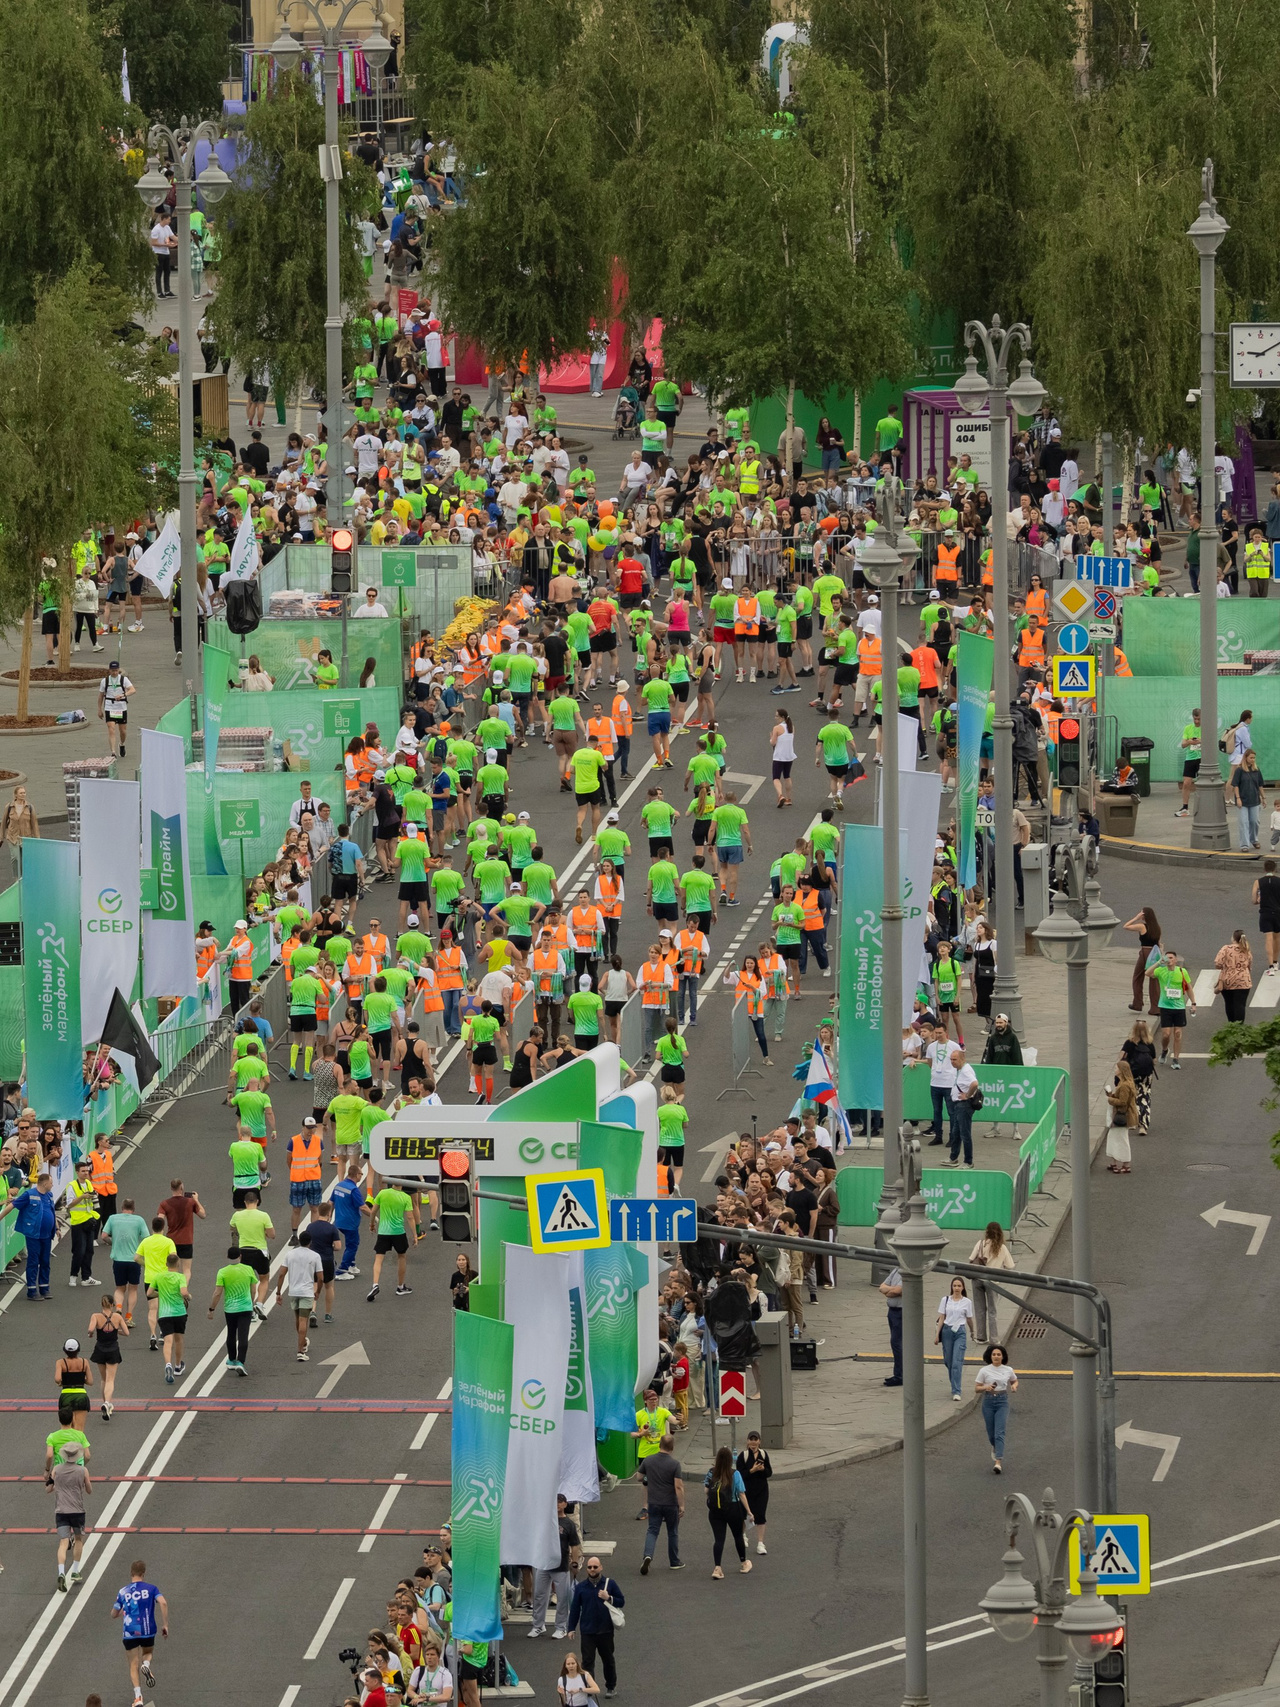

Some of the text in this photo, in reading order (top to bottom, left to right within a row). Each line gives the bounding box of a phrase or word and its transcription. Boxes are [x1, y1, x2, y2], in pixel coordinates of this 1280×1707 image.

[955, 424, 991, 432] ОШИБ
[955, 434, 976, 443] 404
[160, 827, 175, 887] Прайм
[87, 919, 133, 934] СБЕР
[854, 947, 869, 1020] зелёный
[868, 954, 883, 1030] марафон
[37, 958, 52, 1032] зелёный
[53, 966, 68, 1042] марафон
[458, 1380, 506, 1402] зелёный
[458, 1395, 505, 1414] марафон
[509, 1413, 556, 1435] СБЕР
